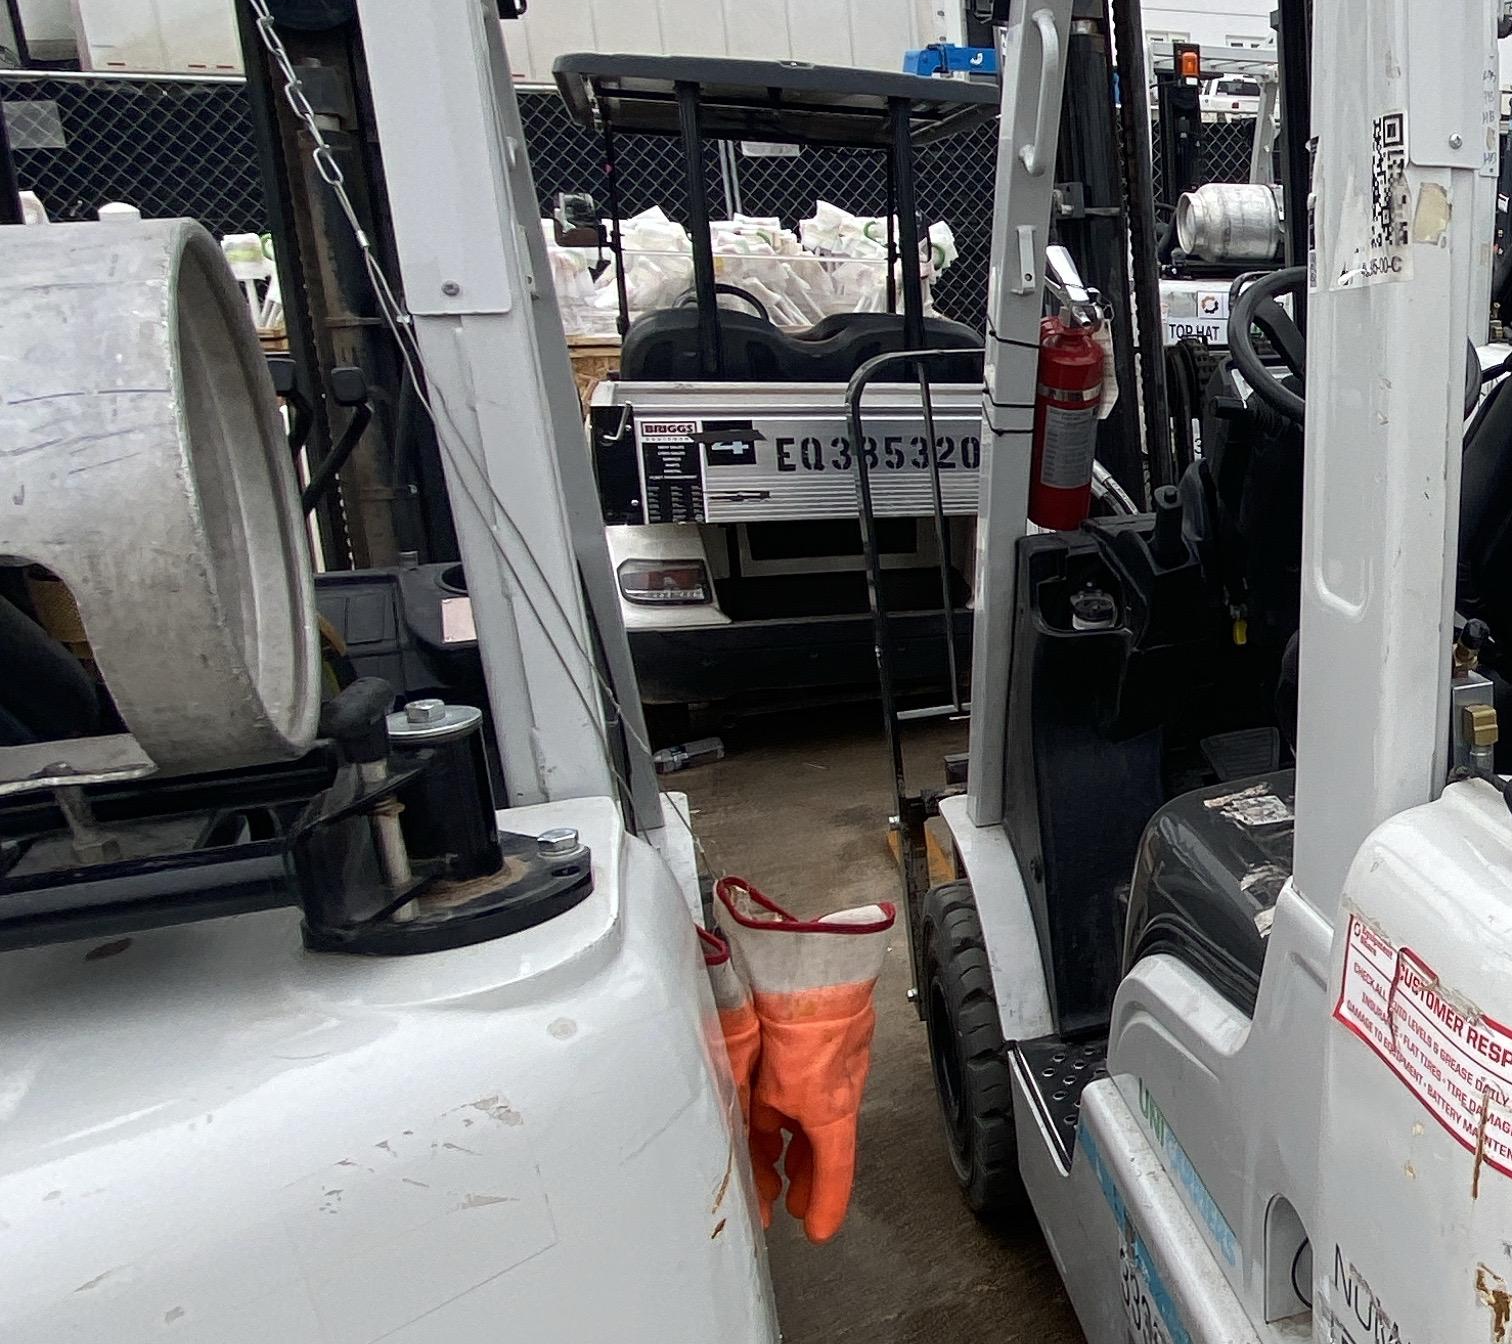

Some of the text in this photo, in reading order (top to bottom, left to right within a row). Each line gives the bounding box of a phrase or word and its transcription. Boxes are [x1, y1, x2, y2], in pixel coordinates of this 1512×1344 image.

[644, 424, 694, 434] BRIGGS
[776, 436, 981, 472] EQ385320
[1400, 962, 1464, 1038] CUSTOMER
[1374, 1026, 1383, 1043] TO
[1427, 1083, 1463, 1125] BATTERY
[1403, 1034, 1419, 1056] FLAT
[1420, 1051, 1442, 1082] TIRES
[1447, 1079, 1467, 1108] TIRE
[1407, 1015, 1432, 1047] LEVELS
[1440, 1048, 1473, 1086] GREASE
[1475, 1077, 1510, 1107] DAILY
